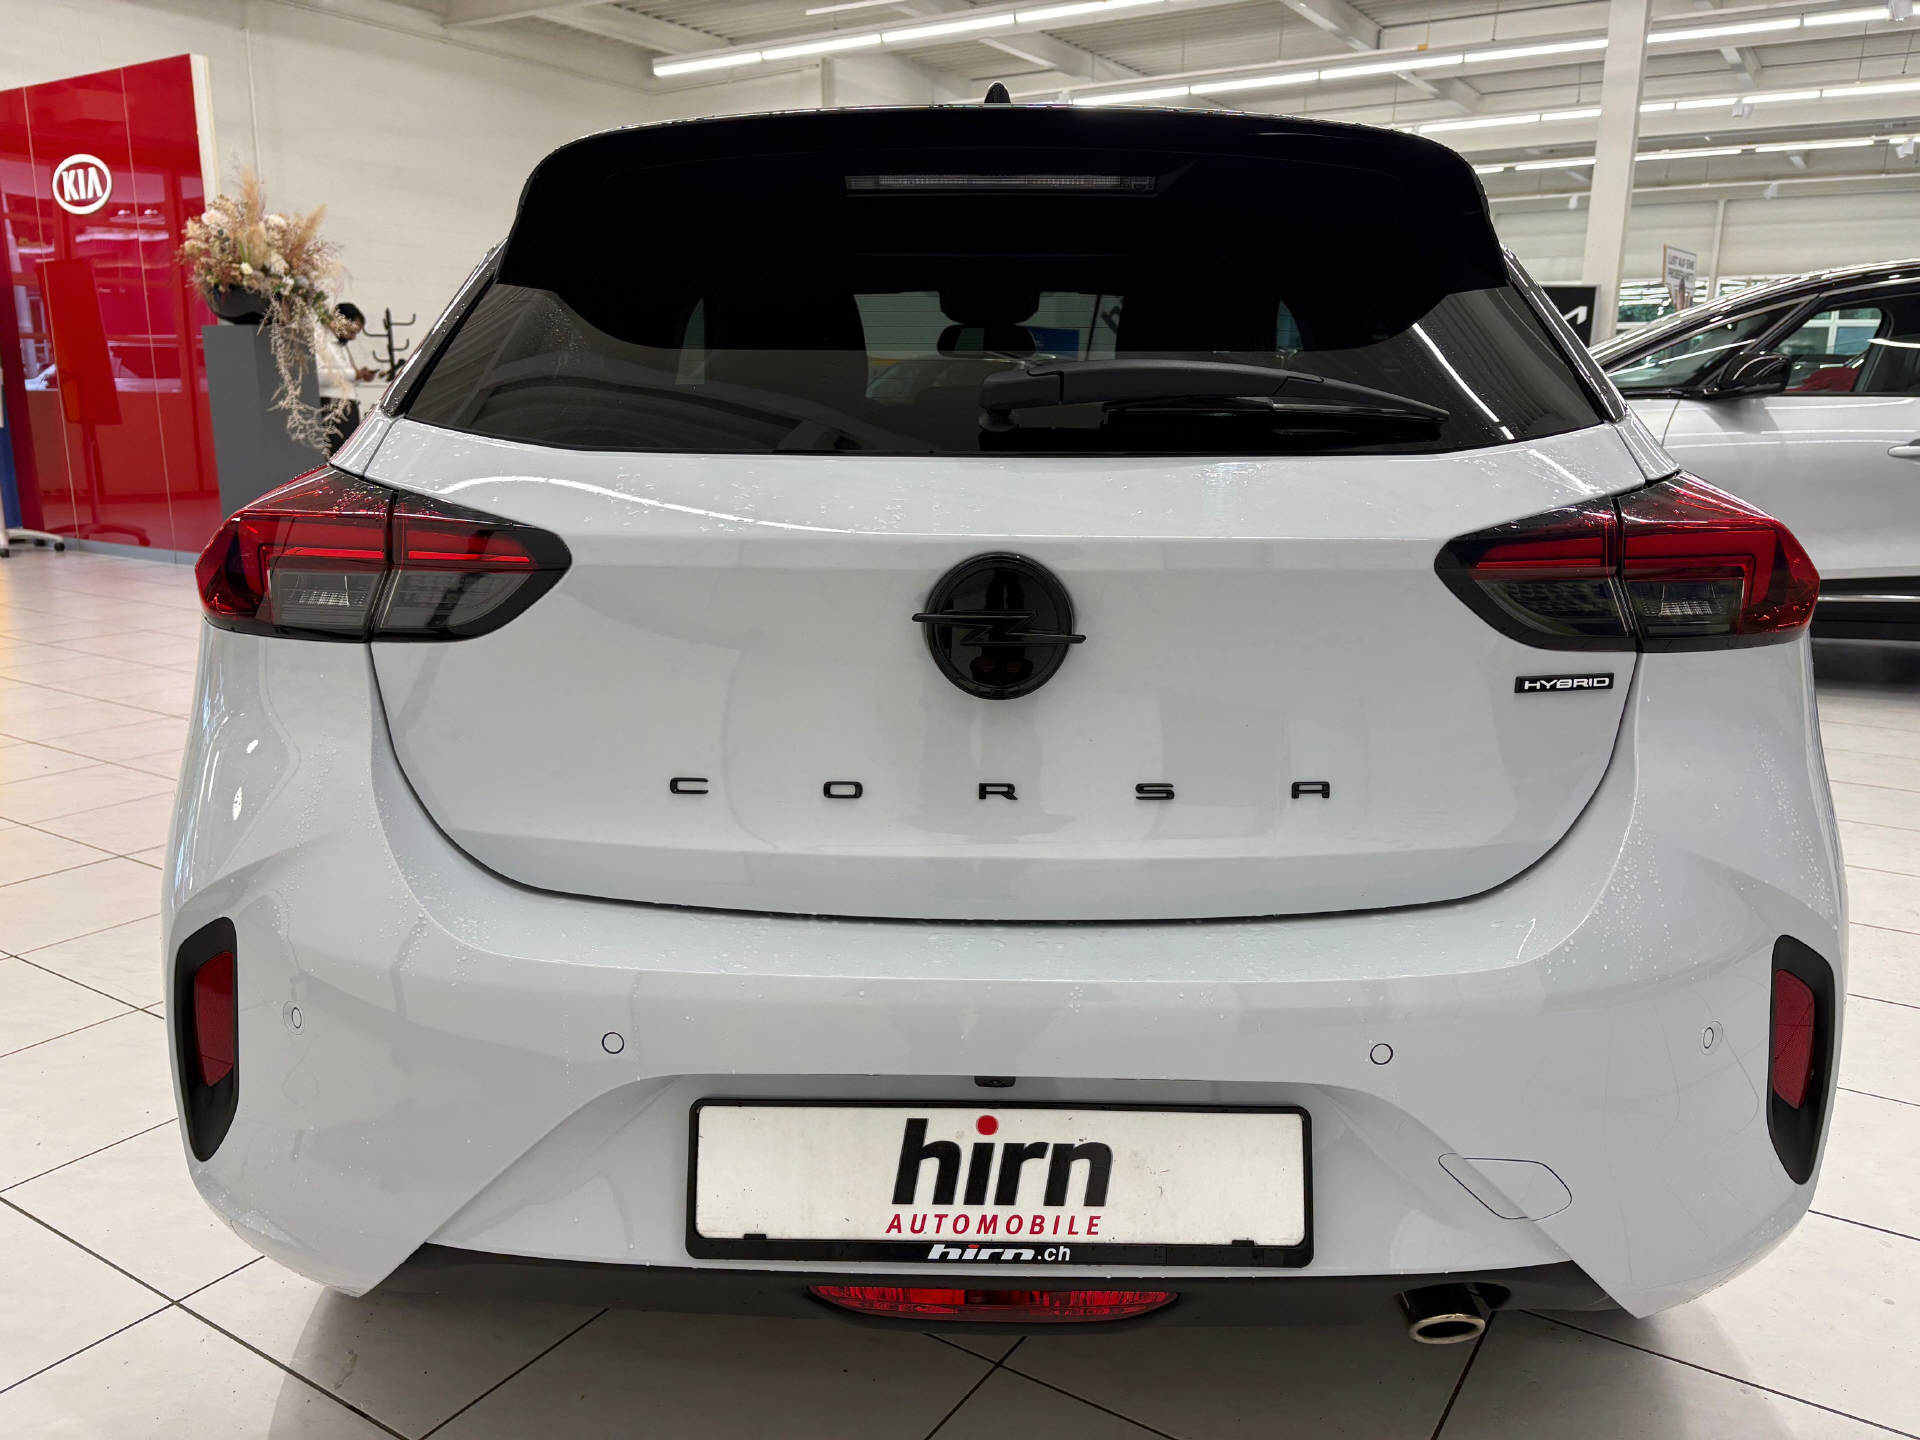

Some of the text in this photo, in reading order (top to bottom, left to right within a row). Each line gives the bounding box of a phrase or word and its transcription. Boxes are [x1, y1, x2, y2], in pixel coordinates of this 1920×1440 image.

[61, 166, 103, 202] KIA
[1523, 677, 1610, 690] HYBRID
[892, 1114, 1114, 1207] hirn
[885, 1213, 1102, 1236] AUTOMOBILE
[927, 1243, 1071, 1262] hirn.ch
